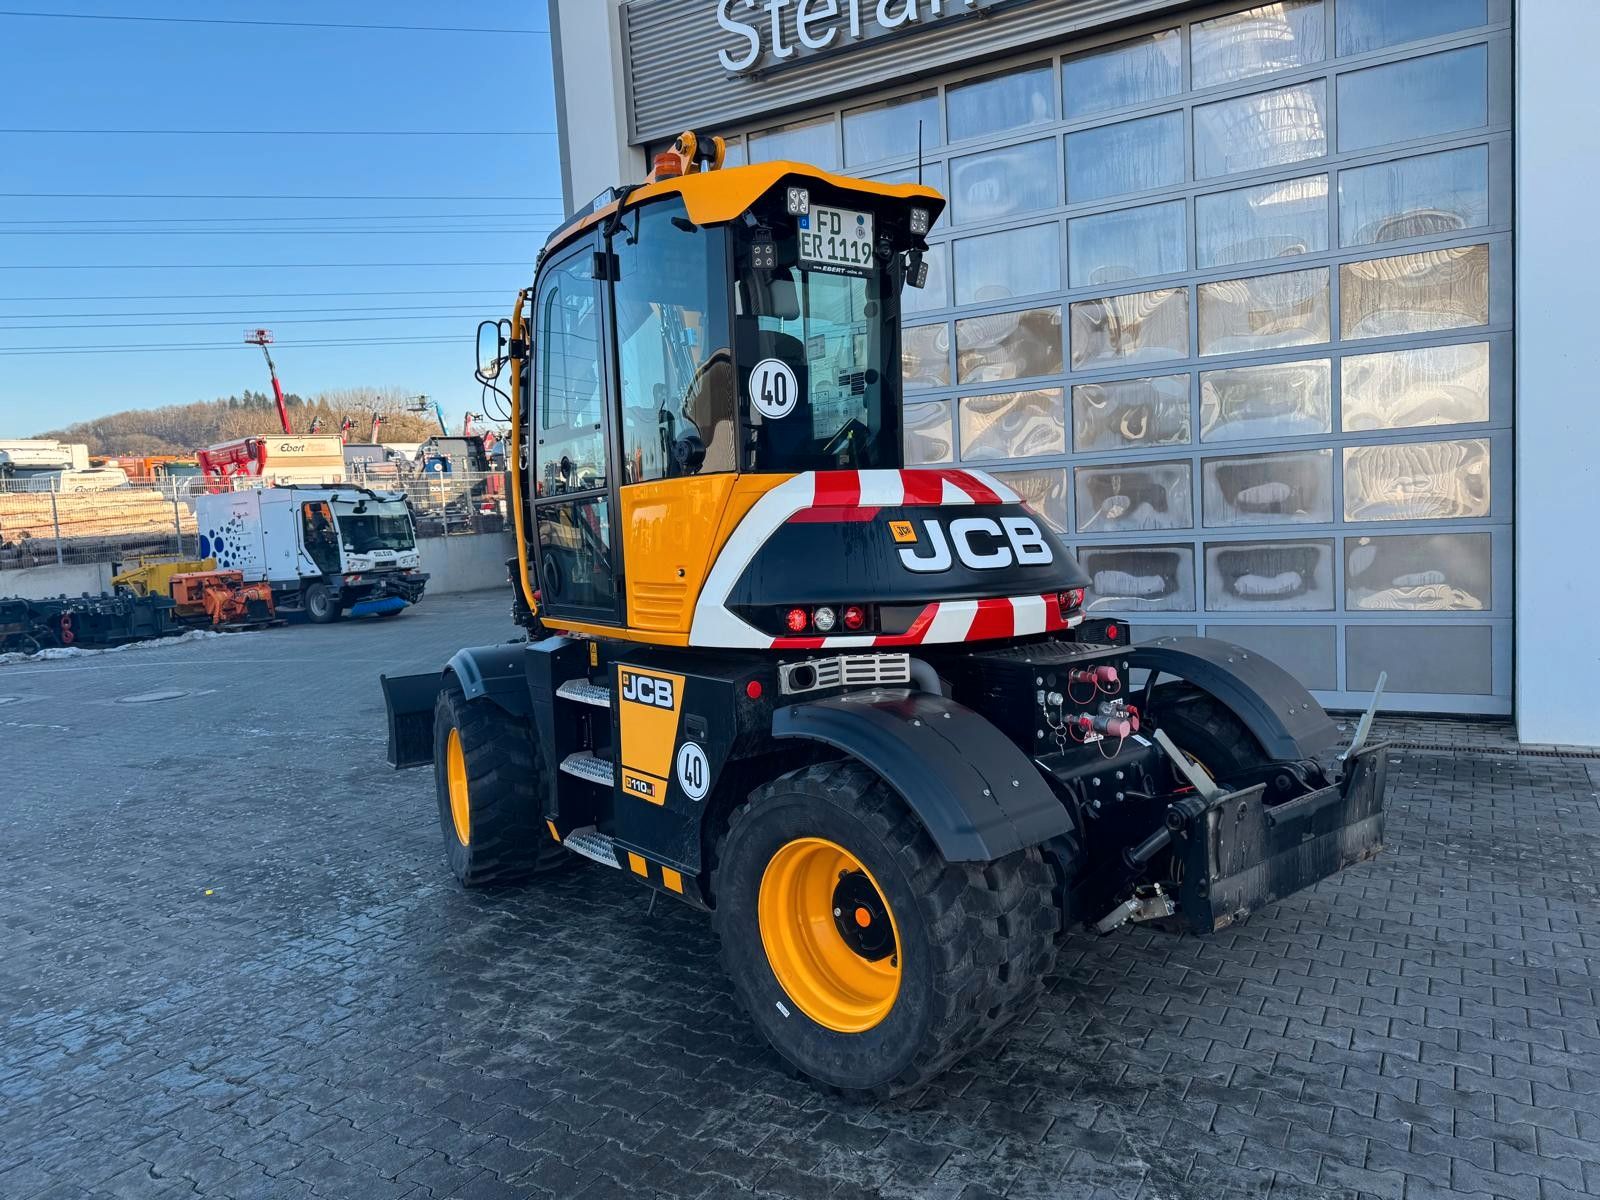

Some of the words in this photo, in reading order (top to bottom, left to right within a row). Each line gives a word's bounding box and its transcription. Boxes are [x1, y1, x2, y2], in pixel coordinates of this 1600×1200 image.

[817, 210, 842, 235] FD
[801, 232, 823, 258] ER
[828, 236, 872, 264] 1119
[760, 370, 787, 406] 40
[280, 442, 305, 452] Ebert
[897, 526, 911, 536] JCB
[898, 517, 1054, 571] JCB
[623, 675, 673, 708] JCB
[684, 753, 702, 789] 40
